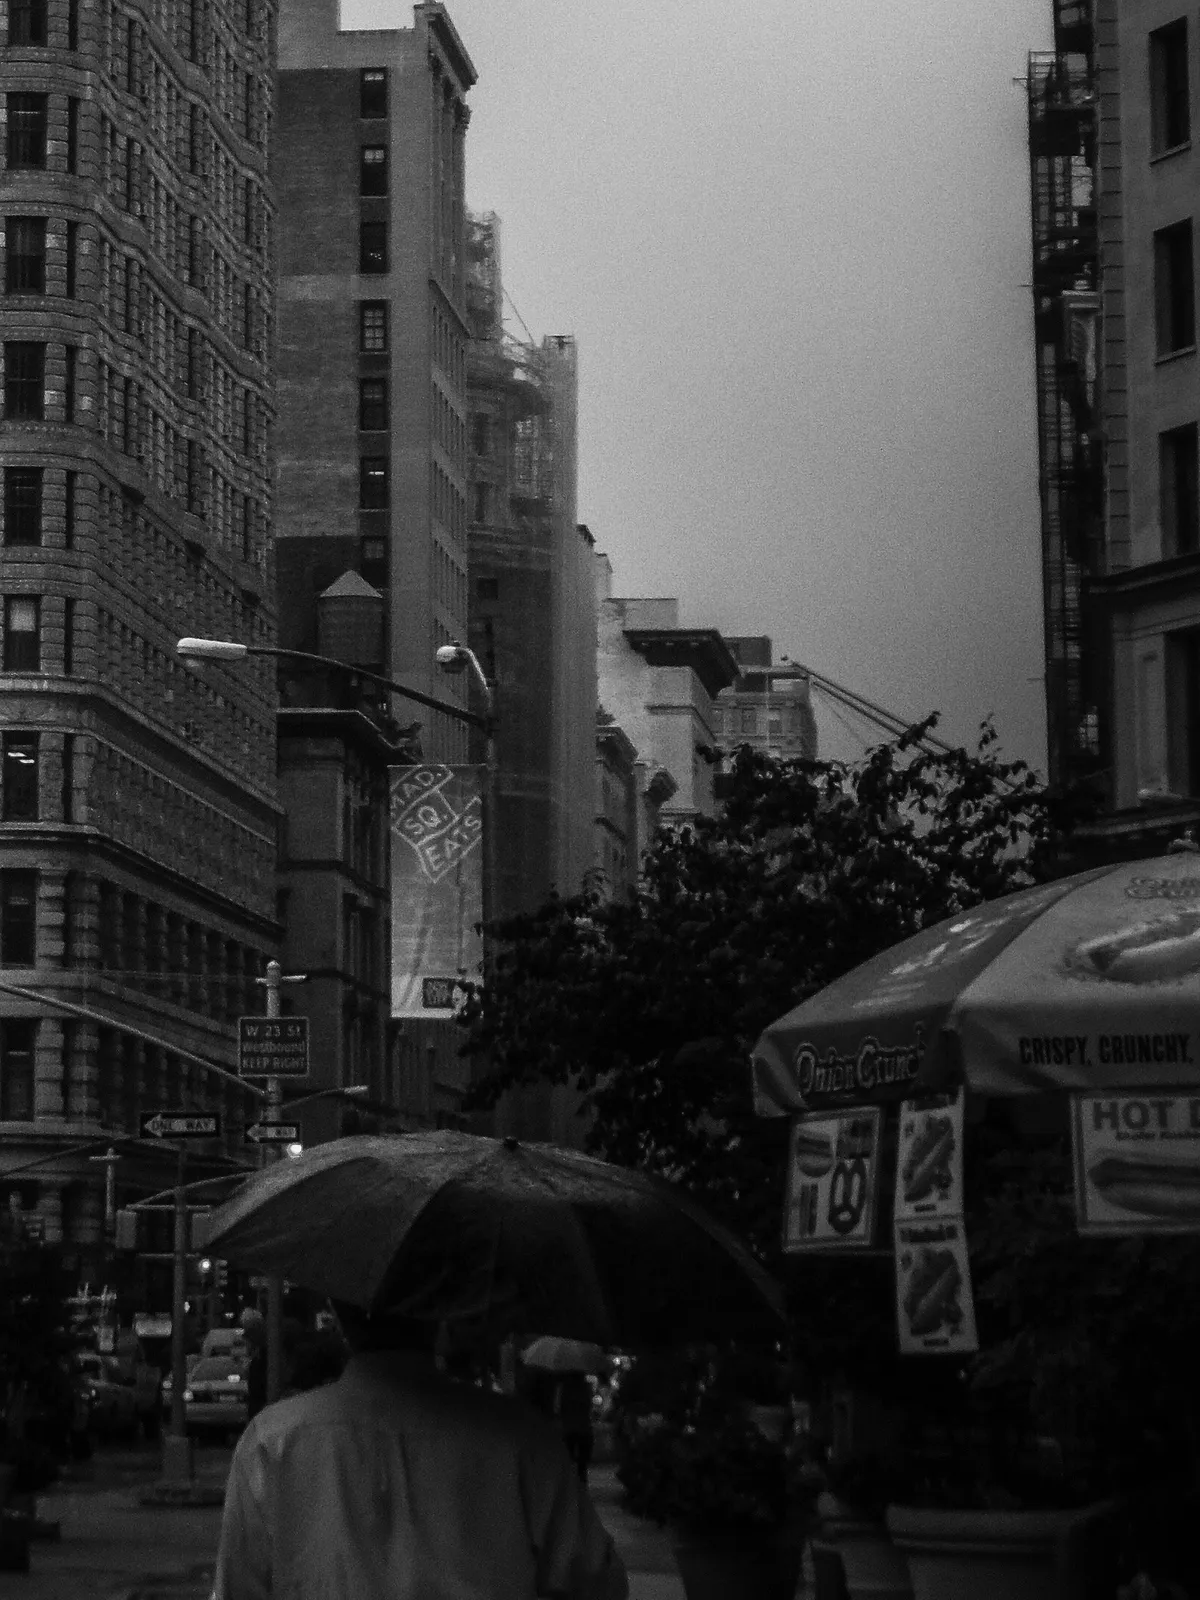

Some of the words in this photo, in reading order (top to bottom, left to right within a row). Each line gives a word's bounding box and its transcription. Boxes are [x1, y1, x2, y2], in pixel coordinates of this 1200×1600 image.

[404, 805, 449, 836] SQ.
[425, 815, 482, 872] EATS
[245, 1025, 259, 1037] W
[1093, 1101, 1175, 1130] HOT
